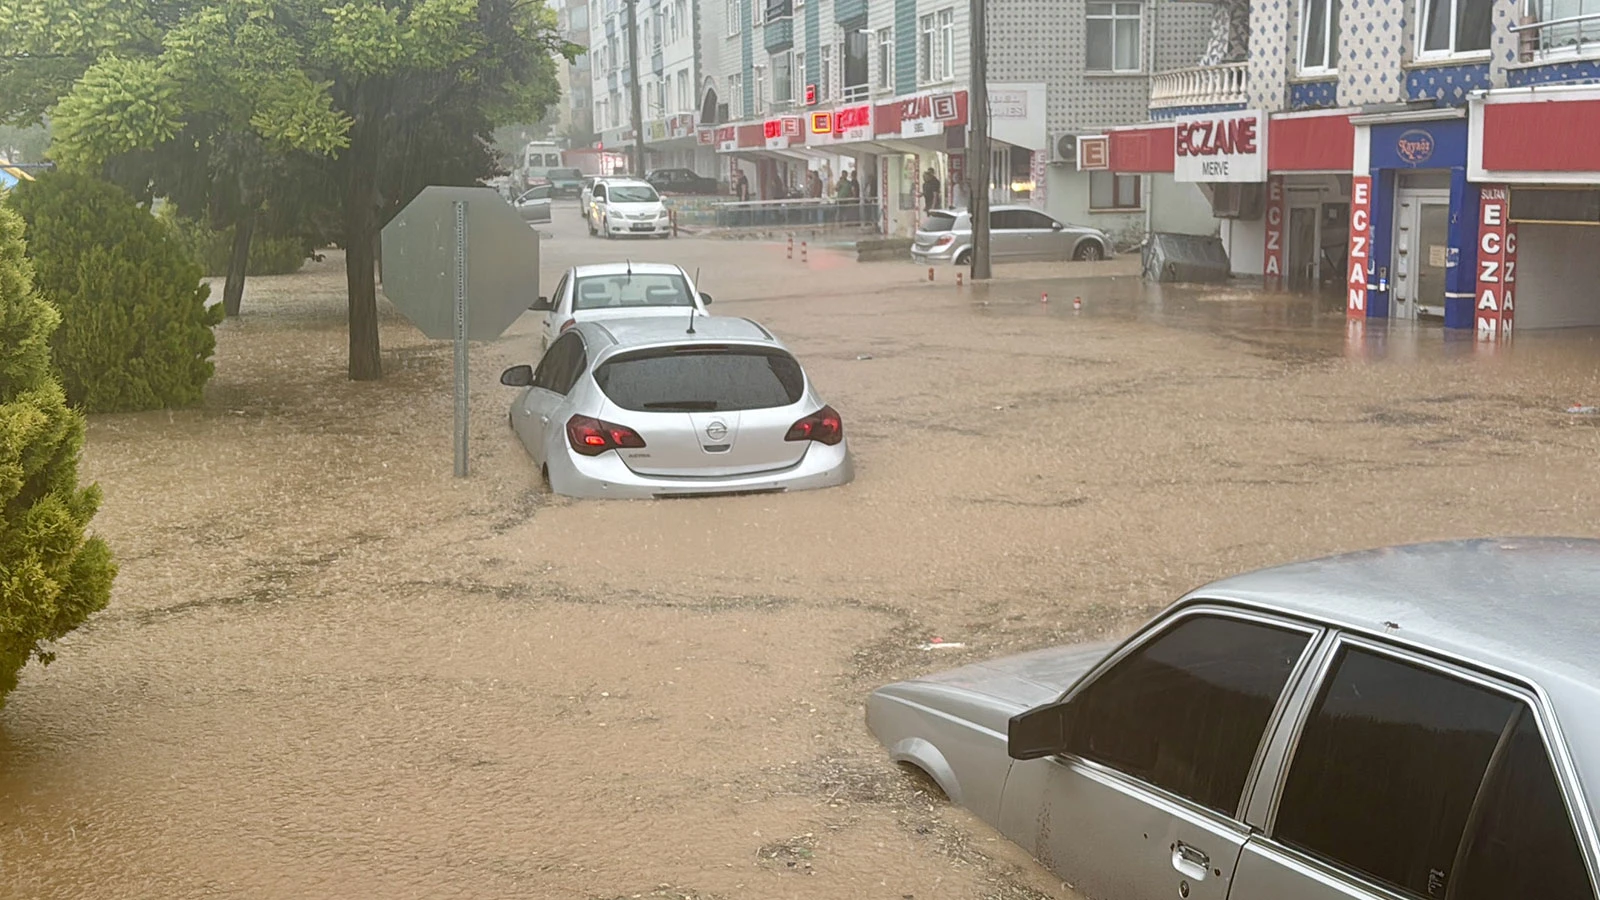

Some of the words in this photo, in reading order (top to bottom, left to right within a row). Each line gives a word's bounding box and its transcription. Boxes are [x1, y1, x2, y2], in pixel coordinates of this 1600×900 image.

[1177, 117, 1257, 157] ECZANE
[1202, 161, 1229, 176] MERVE
[1480, 189, 1505, 200] SULTAN
